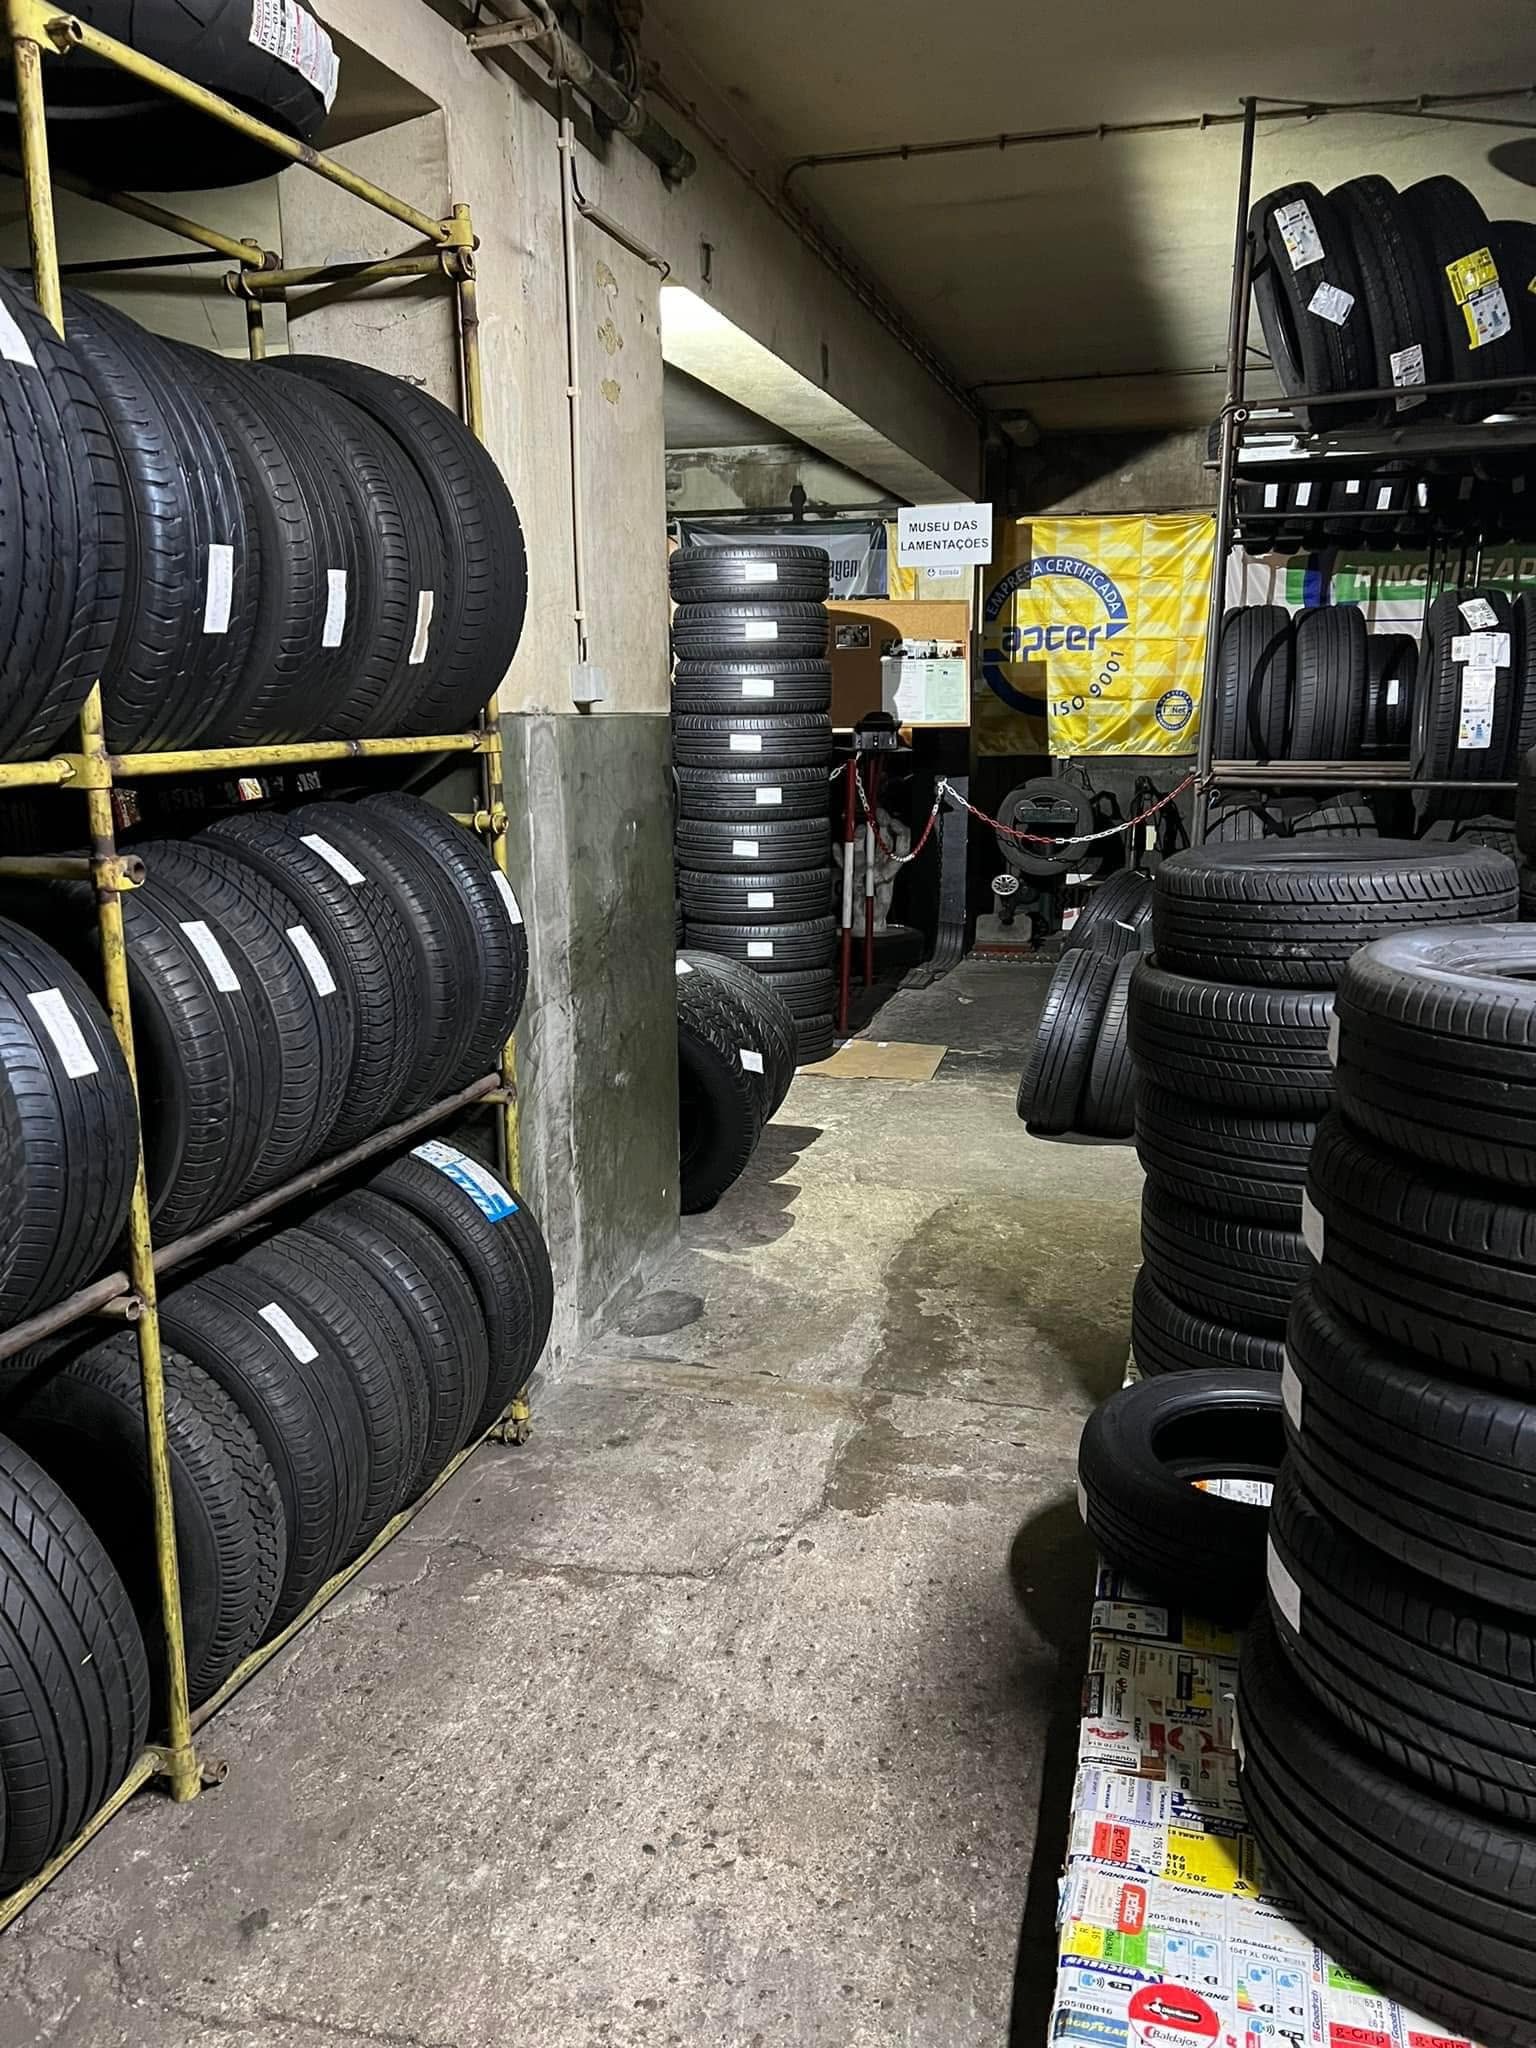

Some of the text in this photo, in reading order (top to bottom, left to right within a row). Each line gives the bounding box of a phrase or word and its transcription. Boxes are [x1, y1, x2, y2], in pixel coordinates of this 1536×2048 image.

[908, 520, 978, 533] MUSEU DAS
[987, 559, 1121, 615] EMPRESA CERTIFICADA
[1002, 624, 1102, 664] apcer
[1053, 650, 1125, 717] ISO 9001
[1113, 1828, 1128, 1858] g-Grip
[1098, 1870, 1149, 1884] NANKANG
[1164, 1867, 1207, 1883] 205/65
[1172, 1885, 1224, 1900] NANKANG
[1152, 2029, 1199, 2048] Baldajos
[1335, 2026, 1386, 2046] g-Grip
